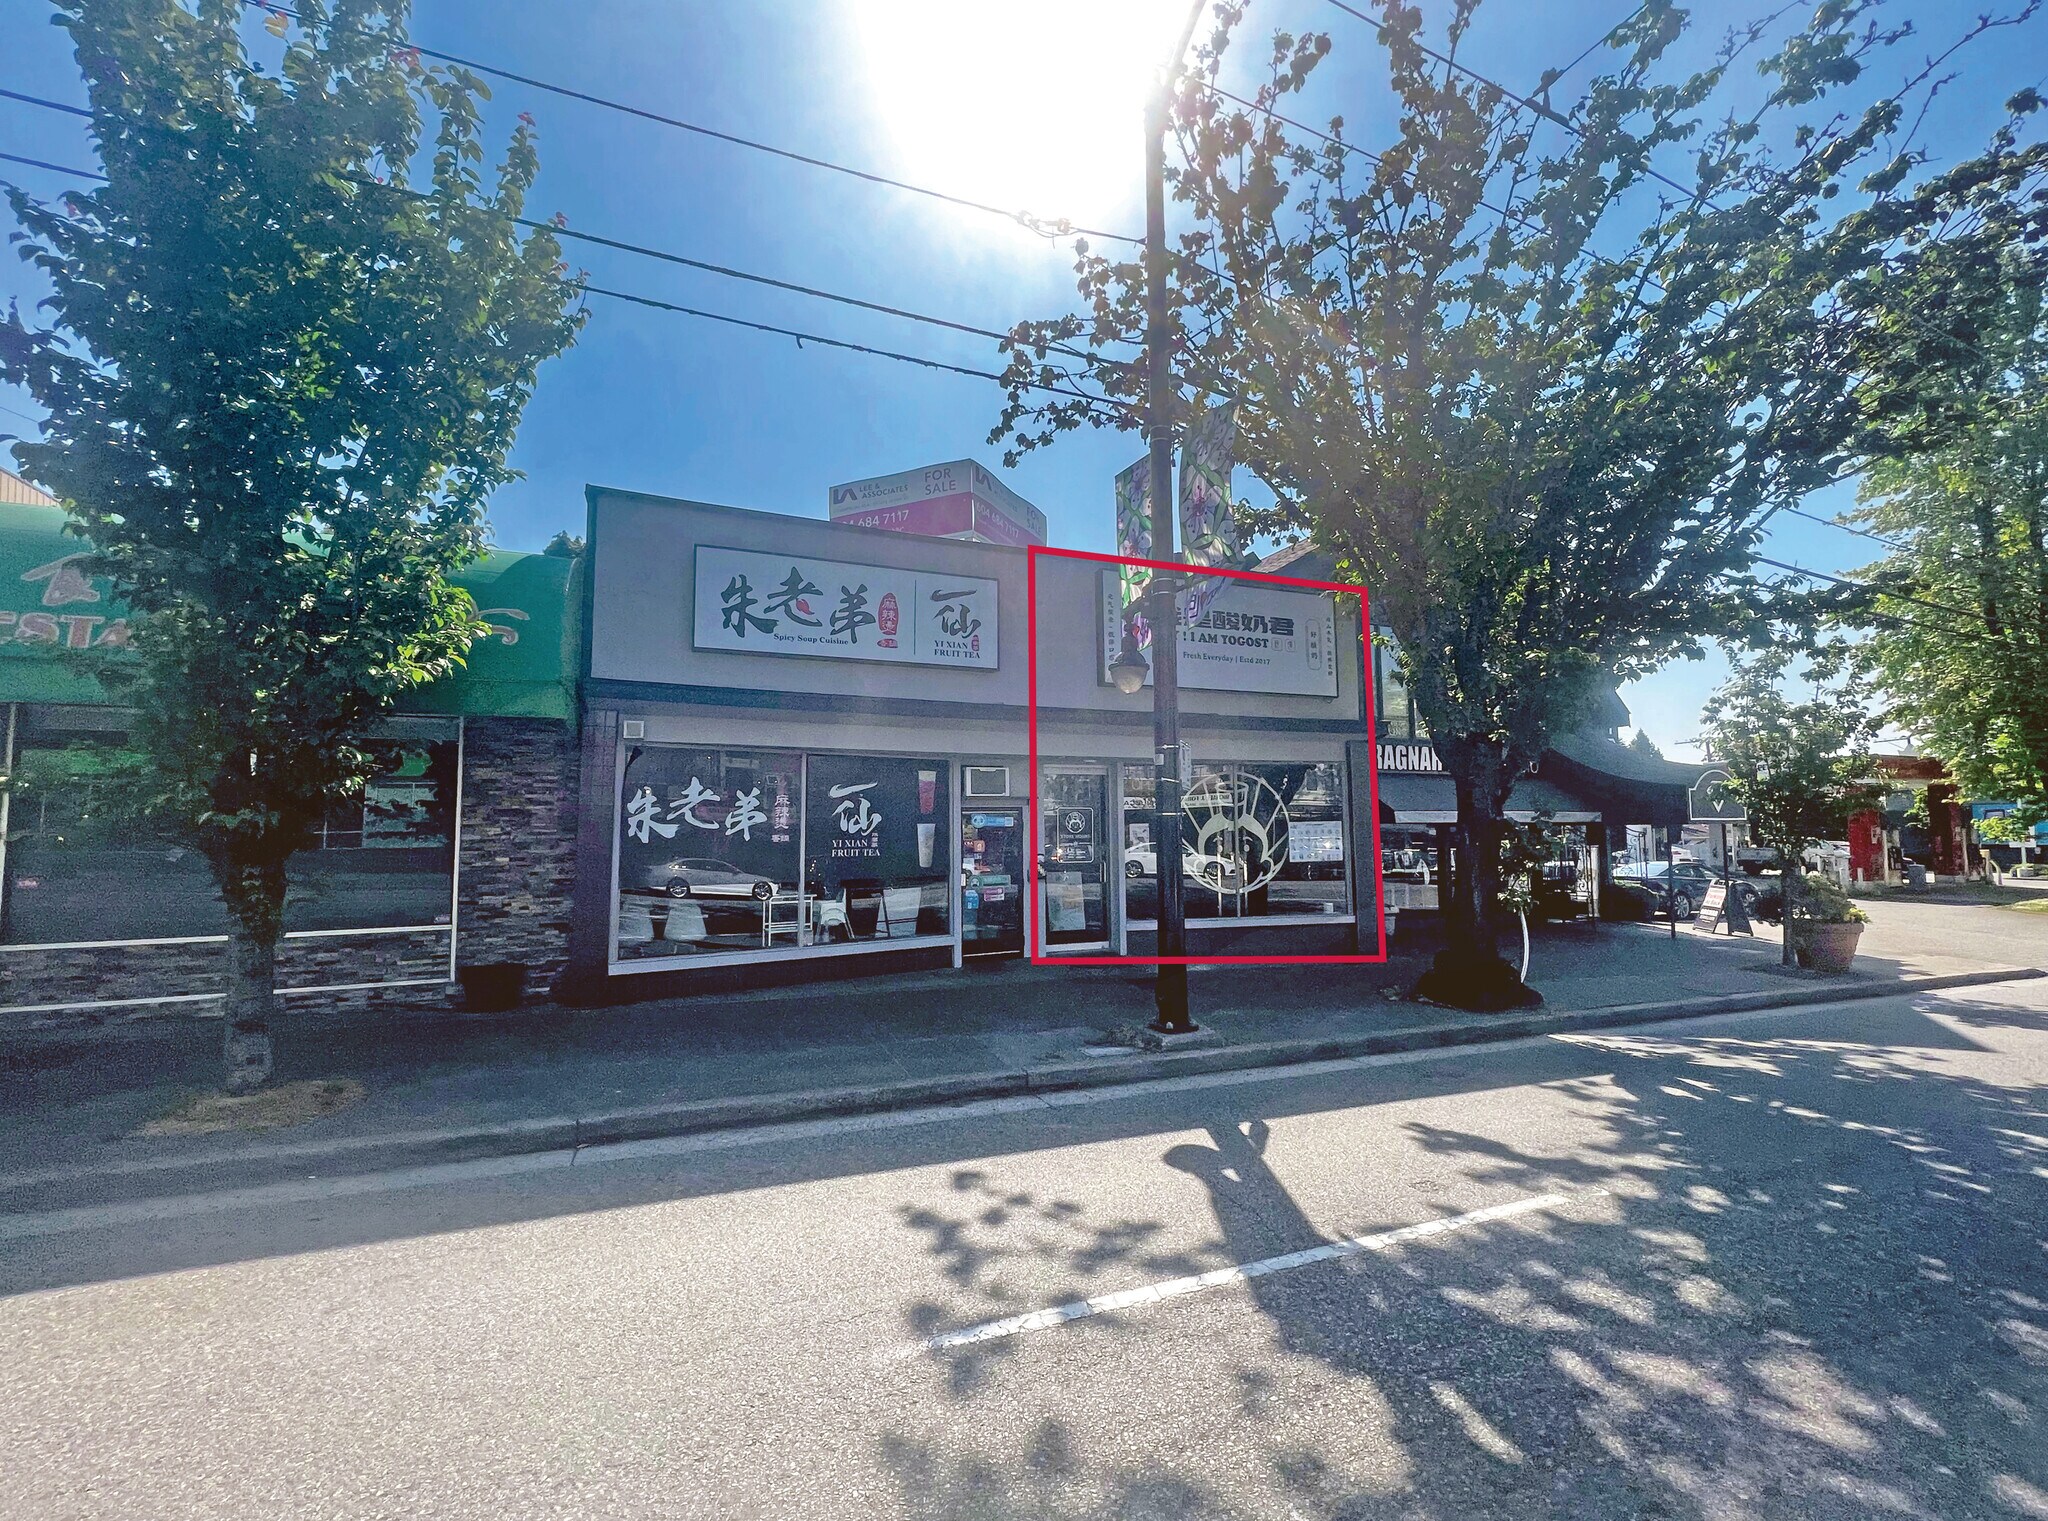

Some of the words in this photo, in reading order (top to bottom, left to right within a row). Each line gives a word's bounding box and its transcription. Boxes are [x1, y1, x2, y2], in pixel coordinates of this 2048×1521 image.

[924, 468, 951, 483] FOR
[859, 484, 873, 493] LEE
[861, 484, 908, 499] ASSOCIATES
[925, 480, 957, 496] SALE
[857, 515, 880, 528] 684
[882, 510, 910, 525] 7117
[976, 502, 990, 518] 604
[1004, 521, 1019, 538] 7117
[720, 566, 876, 644] 朱老弟
[773, 633, 796, 642] Spicy
[797, 635, 818, 644] Soup
[819, 637, 849, 645] Cuisine
[934, 640, 944, 648] YI
[946, 641, 968, 649] XIAN
[1198, 633, 1218, 644] AM
[1220, 635, 1269, 648] YOGOST
[934, 649, 960, 657] FRUIT
[962, 651, 980, 659] TEA
[1183, 651, 1202, 660] Fresh
[1202, 654, 1233, 664] Everyday
[1239, 656, 1254, 664] Estd
[626, 777, 768, 844] 朱老弟
[832, 840, 842, 848] YI
[844, 839, 868, 848] XIAN
[831, 849, 861, 858] FRUIT
[863, 848, 881, 857] TEA
